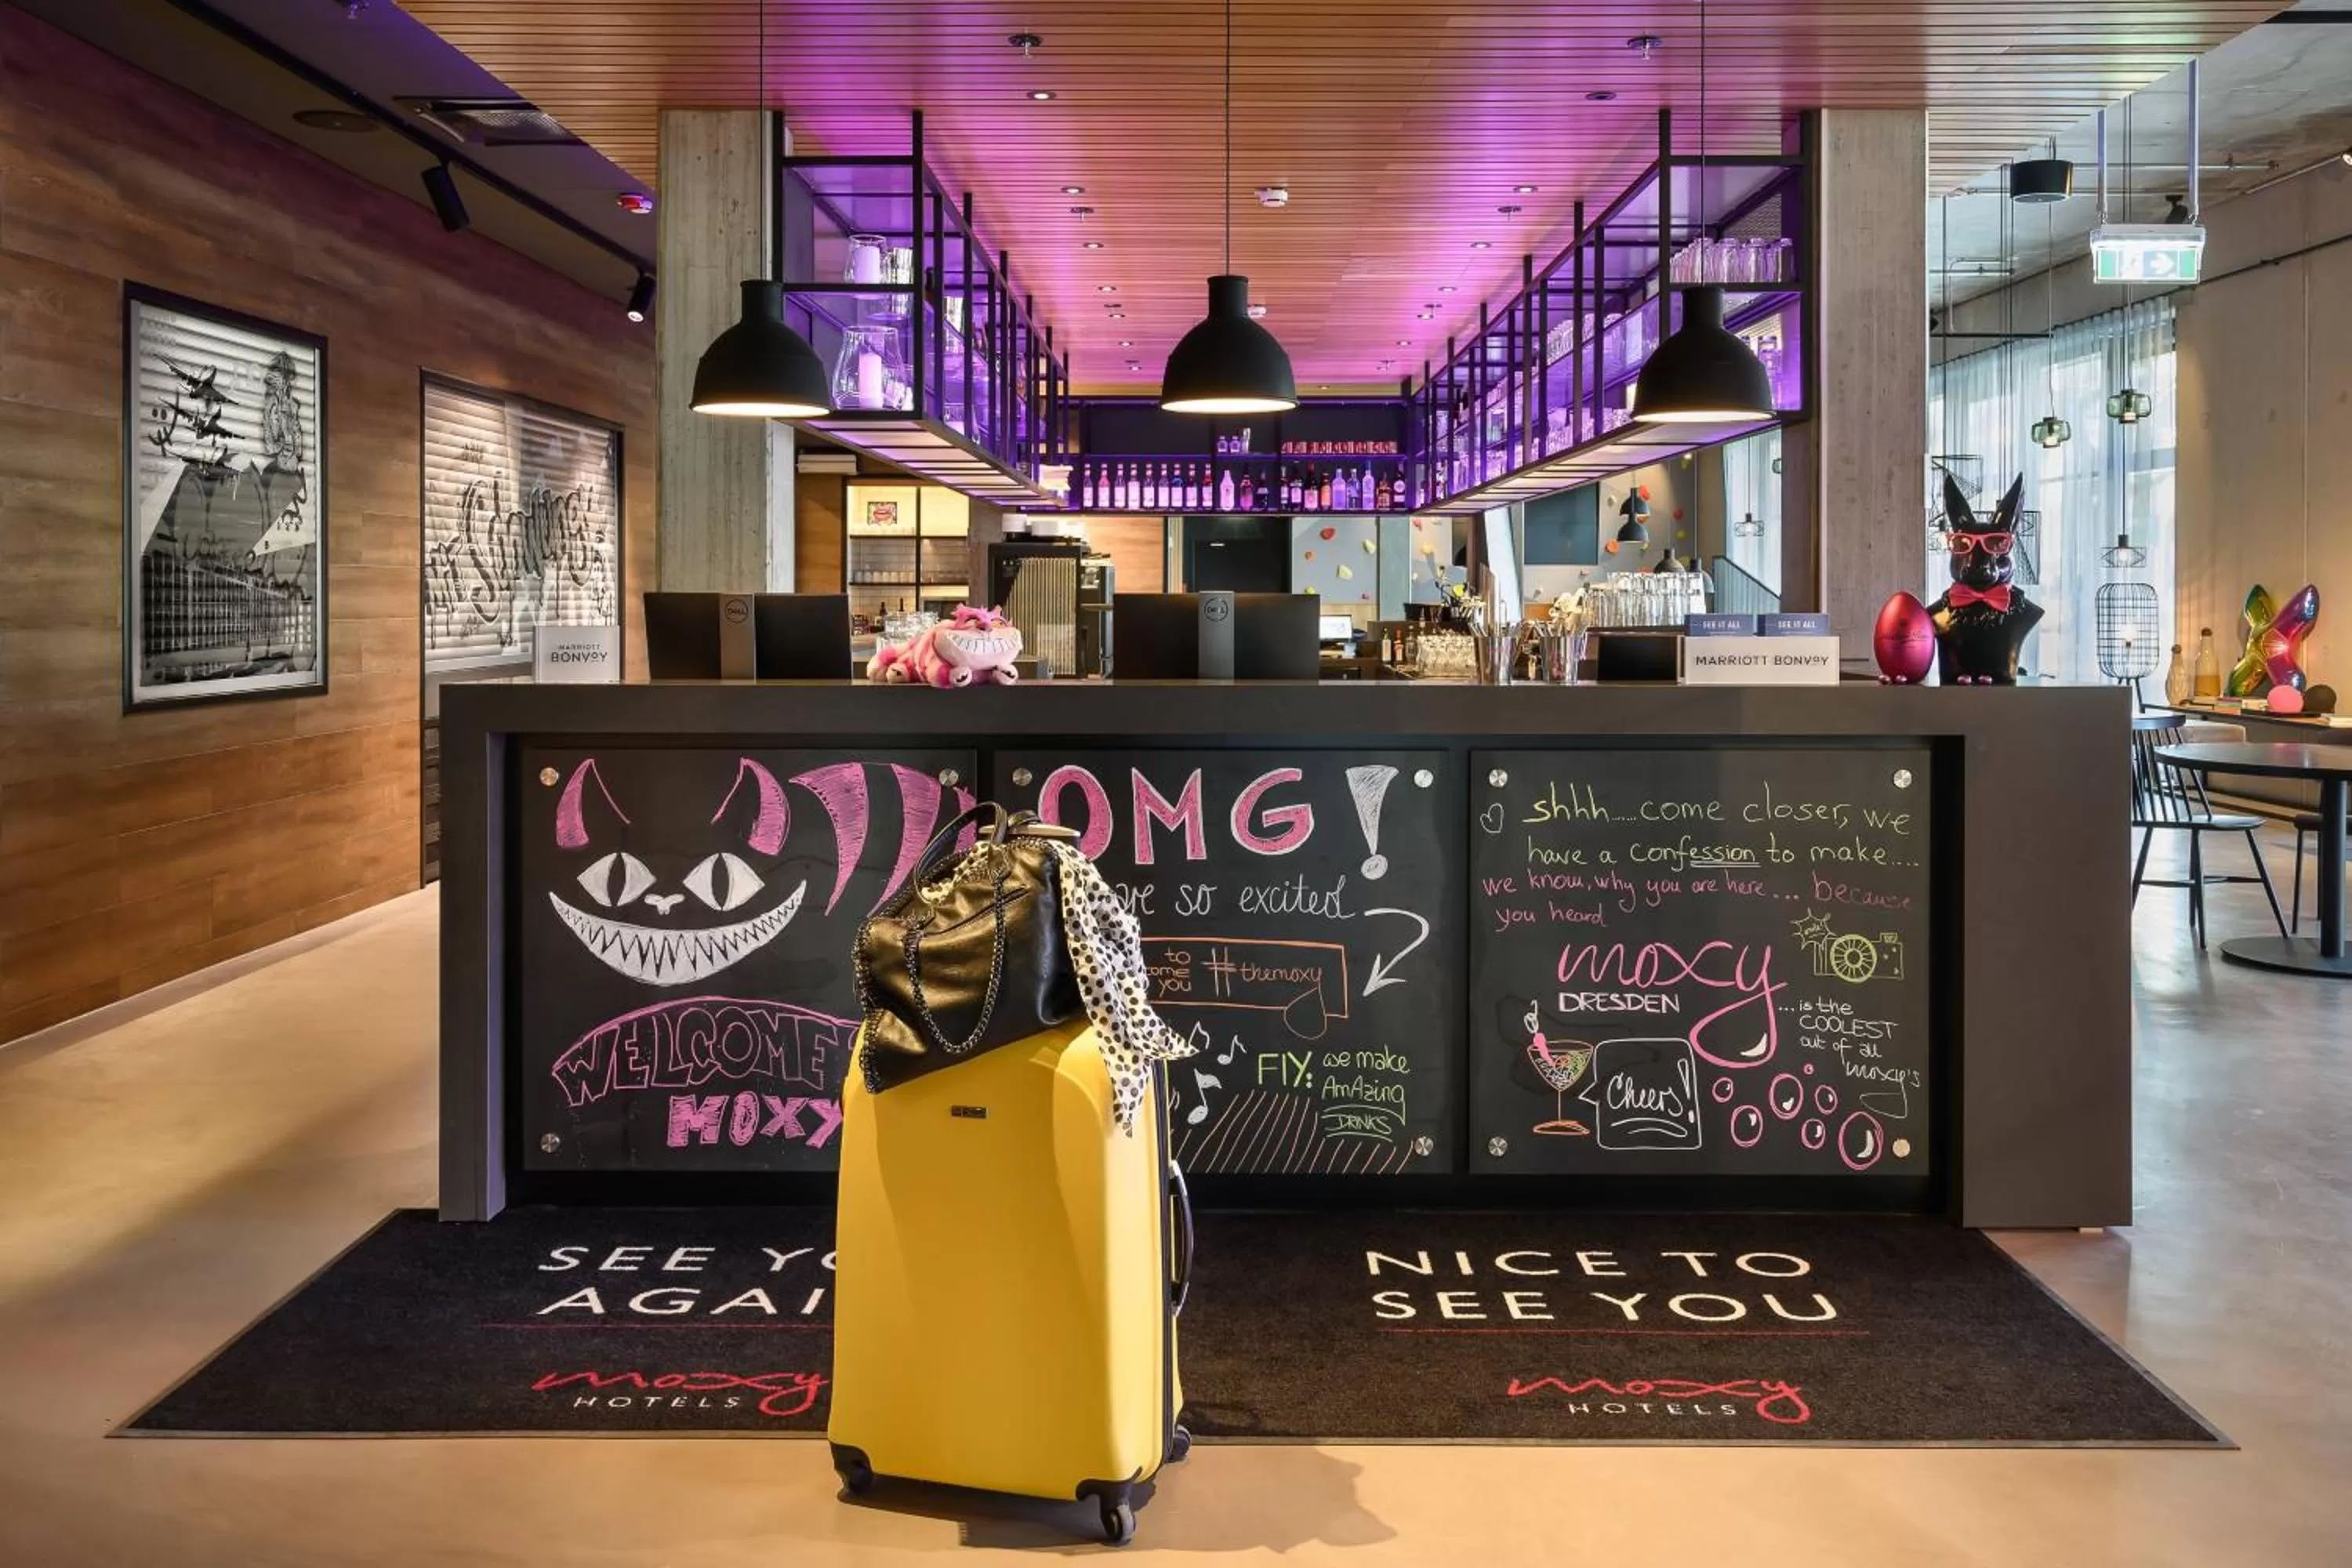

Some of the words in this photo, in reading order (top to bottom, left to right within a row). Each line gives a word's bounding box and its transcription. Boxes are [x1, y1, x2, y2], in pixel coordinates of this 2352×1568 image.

[551, 652, 608, 662] BONVOY
[1696, 655, 1766, 666] MARRIOTT
[1774, 655, 1828, 666] BONVOY
[1743, 780, 1853, 829] closer,
[1863, 808, 1911, 835] we
[1528, 835, 1587, 865] have
[1599, 852, 1617, 864] a
[1766, 832, 1795, 863] to
[1176, 884, 1218, 916] so
[1240, 873, 1356, 919] excited
[1594, 869, 1636, 913] why
[1646, 883, 1682, 907] you
[1691, 878, 1719, 892] are
[1812, 869, 1911, 909] because
[1496, 908, 1536, 932] you
[1549, 901, 1607, 927] heard
[1164, 946, 1191, 965] to
[1159, 978, 1192, 998] you
[1558, 992, 1681, 1014] DRESDEN
[1816, 996, 1854, 1015] the
[1799, 1014, 1900, 1040] COOLEST
[552, 1006, 839, 1107] WELCOME
[1323, 1051, 1351, 1067] we
[1356, 1044, 1410, 1074] make
[1799, 1034, 1826, 1050] out
[1832, 1037, 1853, 1065] of
[1859, 1043, 1882, 1058] all
[1607, 1058, 1695, 1123] Cheers!
[666, 1091, 844, 1149] MOXY
[538, 1247, 715, 1271] SEE
[761, 1247, 837, 1272] Y
[1367, 1250, 1627, 1276] NICE
[1661, 1252, 1810, 1277] TO
[535, 1287, 826, 1316] AGAI
[1372, 1292, 1555, 1319] SEE
[1591, 1294, 1837, 1321] YOU
[573, 1396, 742, 1408] HOTELS
[1569, 1403, 1737, 1415] HOTELS
